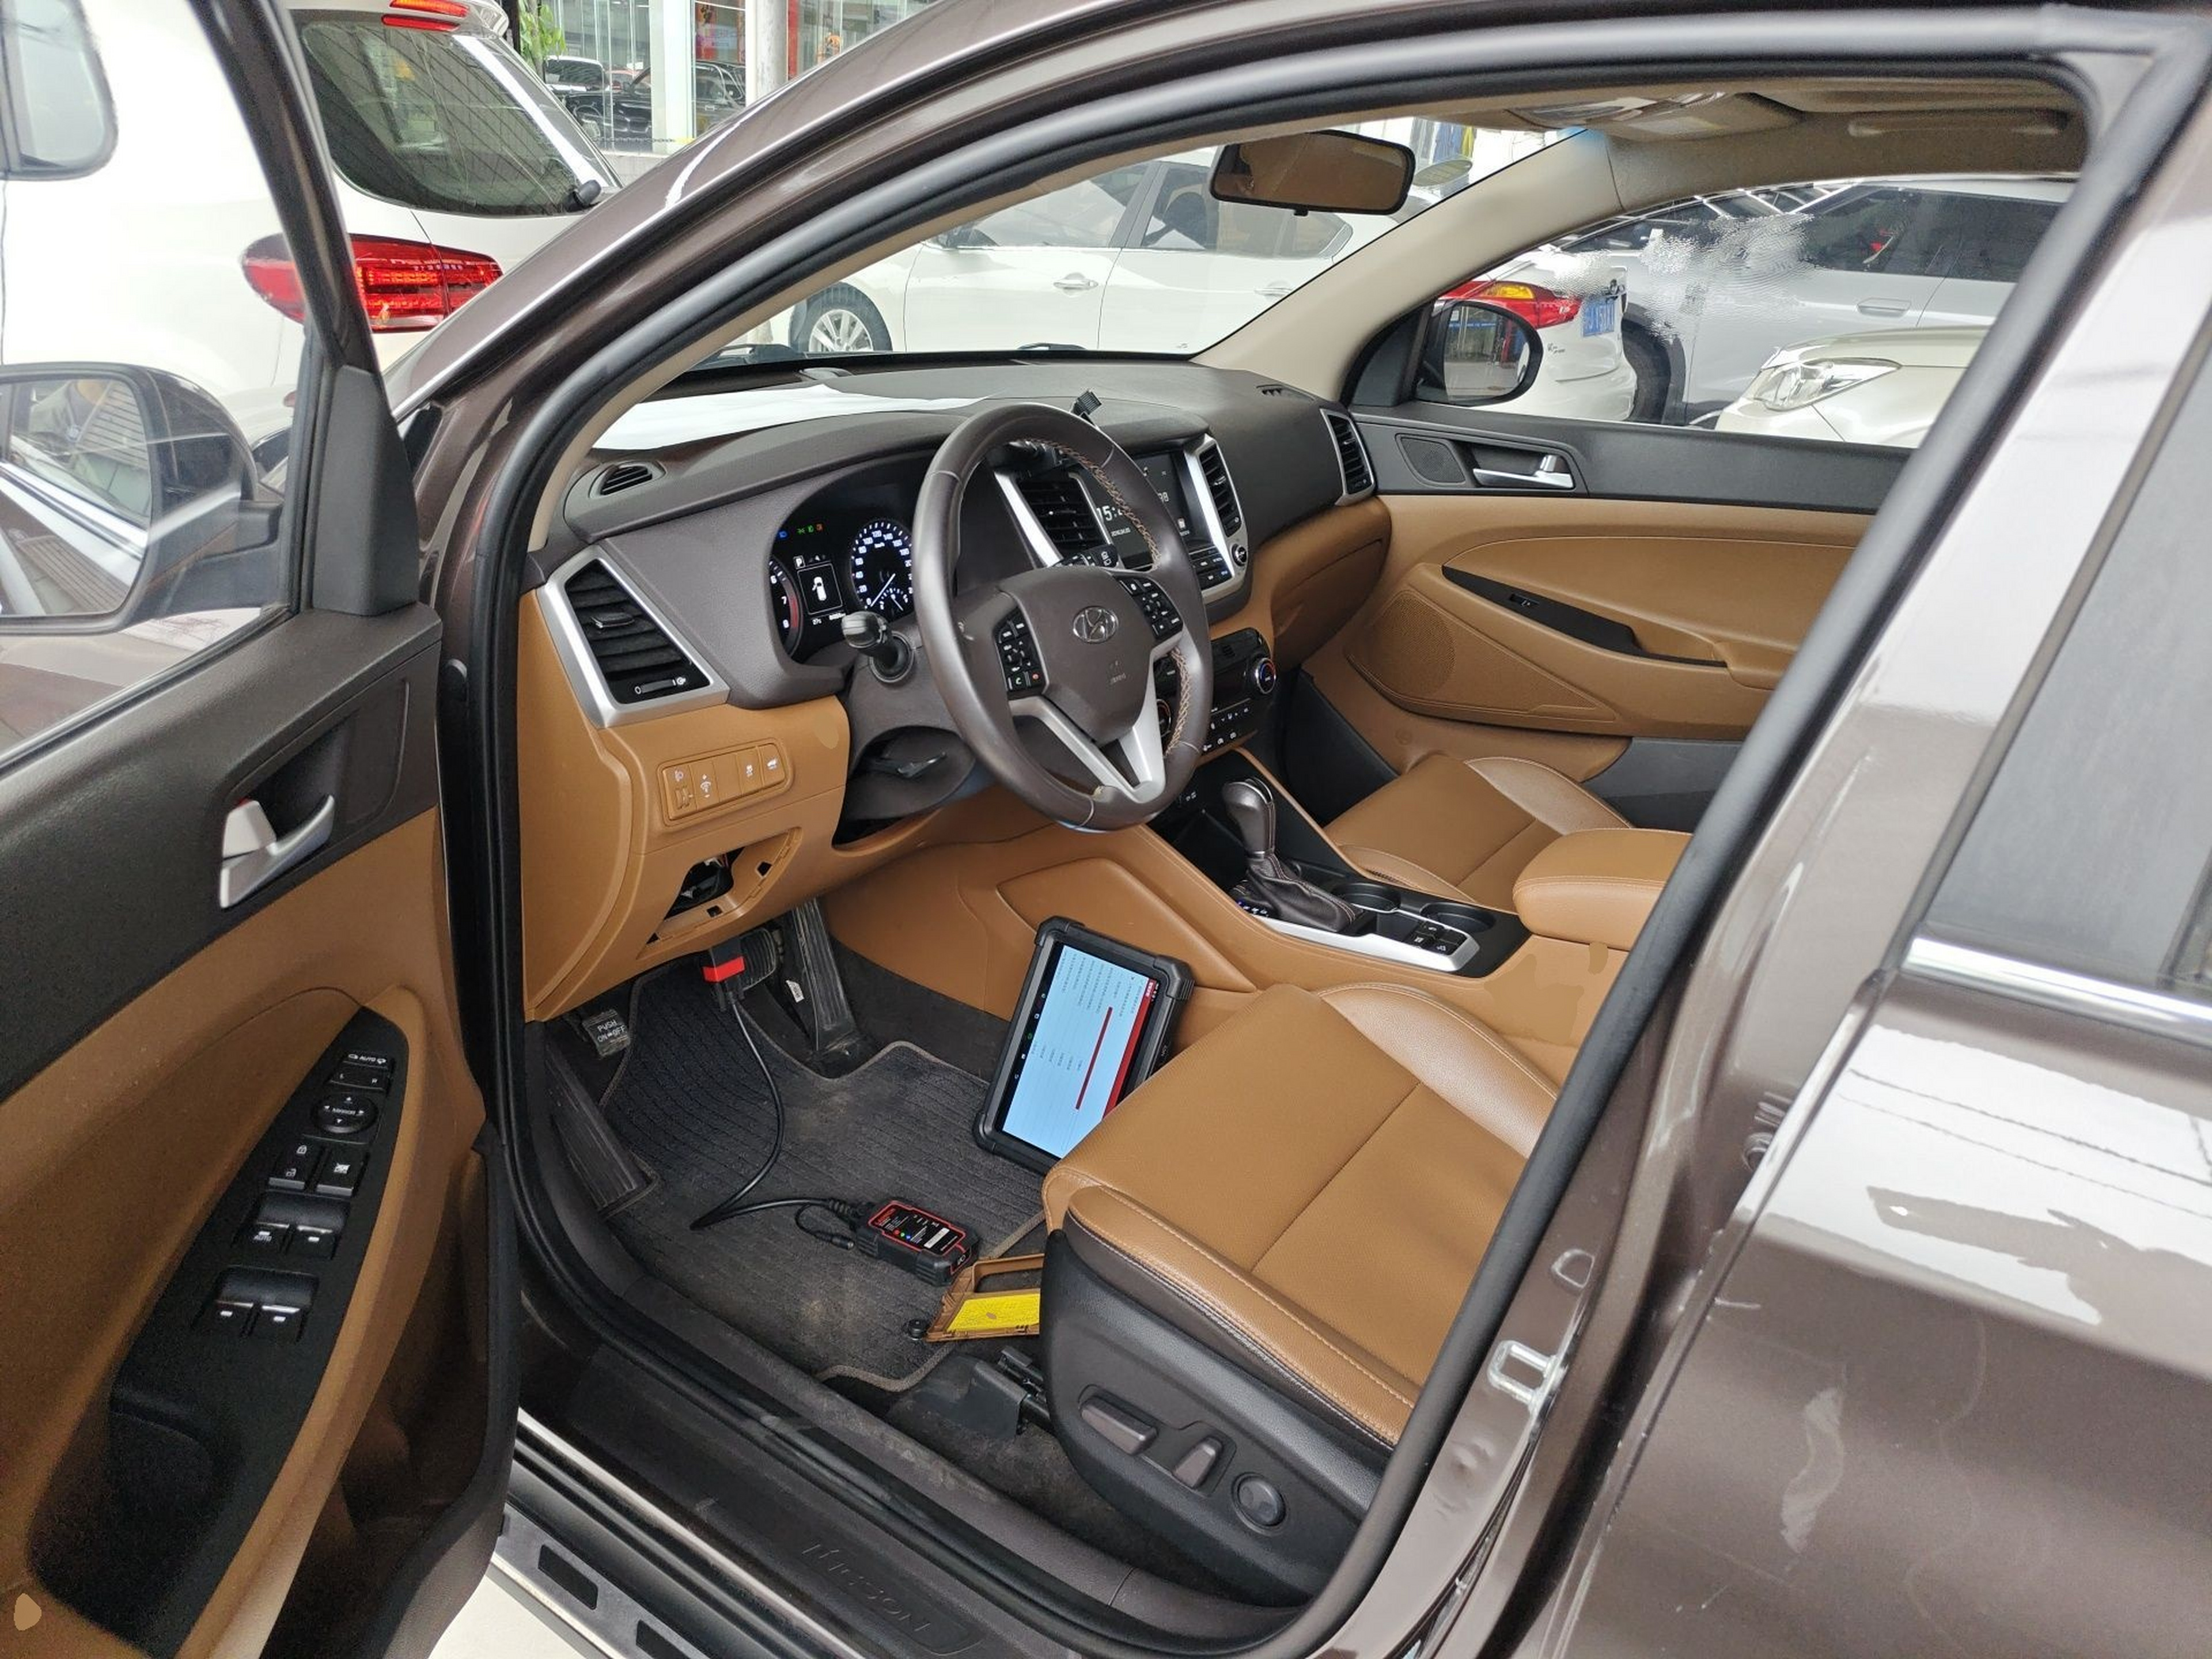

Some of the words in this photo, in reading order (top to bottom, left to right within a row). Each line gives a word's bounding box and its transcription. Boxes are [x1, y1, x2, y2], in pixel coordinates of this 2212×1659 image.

[796, 558, 802, 567] P
[781, 596, 787, 604] 7
[597, 1019, 618, 1032] PUSH
[597, 1034, 608, 1042] ON
[612, 1025, 626, 1036] OFF
